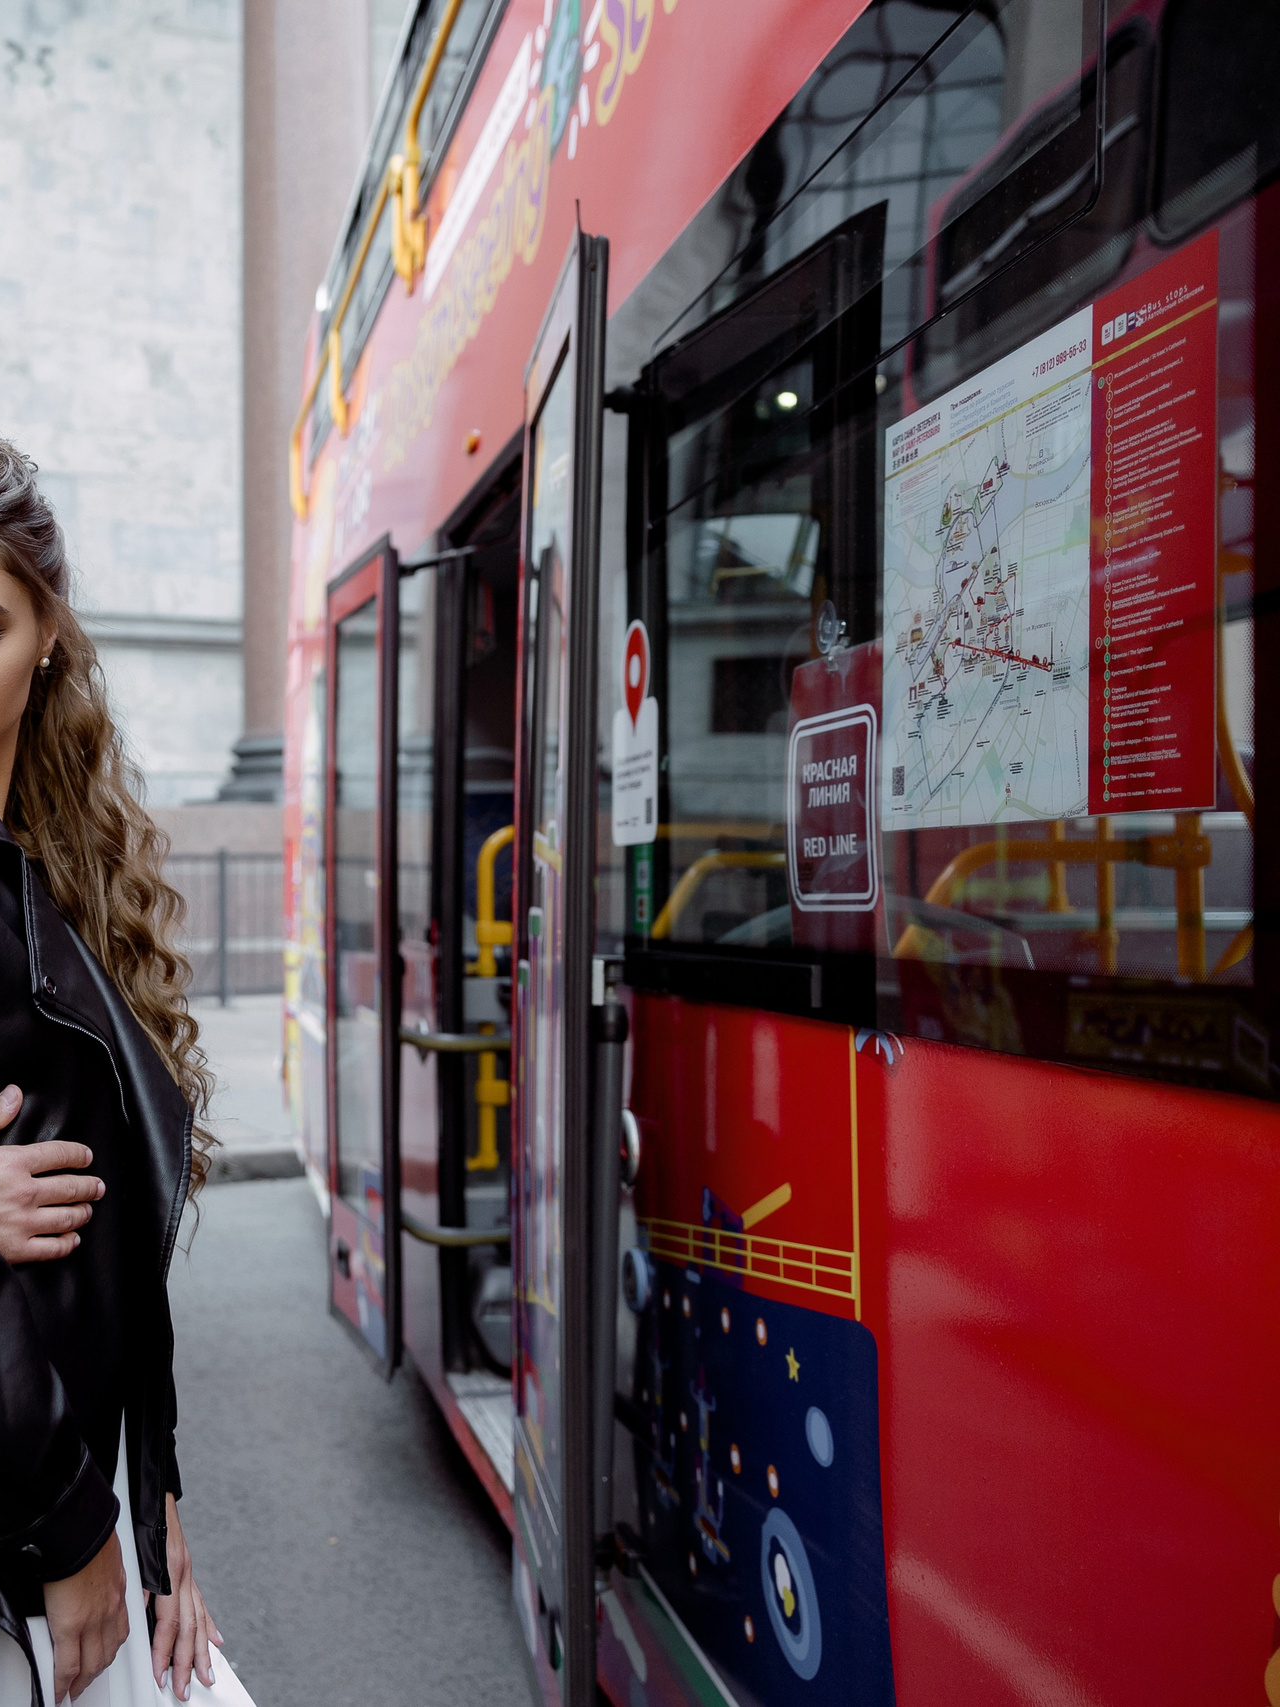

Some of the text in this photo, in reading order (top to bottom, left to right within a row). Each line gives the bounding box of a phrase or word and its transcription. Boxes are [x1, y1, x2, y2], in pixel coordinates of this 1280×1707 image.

[1147, 284, 1188, 313] Bus stops
[1031, 365, 1038, 380] +7
[1055, 338, 1086, 366] 989-55-33
[802, 754, 857, 784] КРАСНАЯ
[807, 782, 850, 809] ЛИНИЯ
[803, 833, 858, 858] RED LINE
